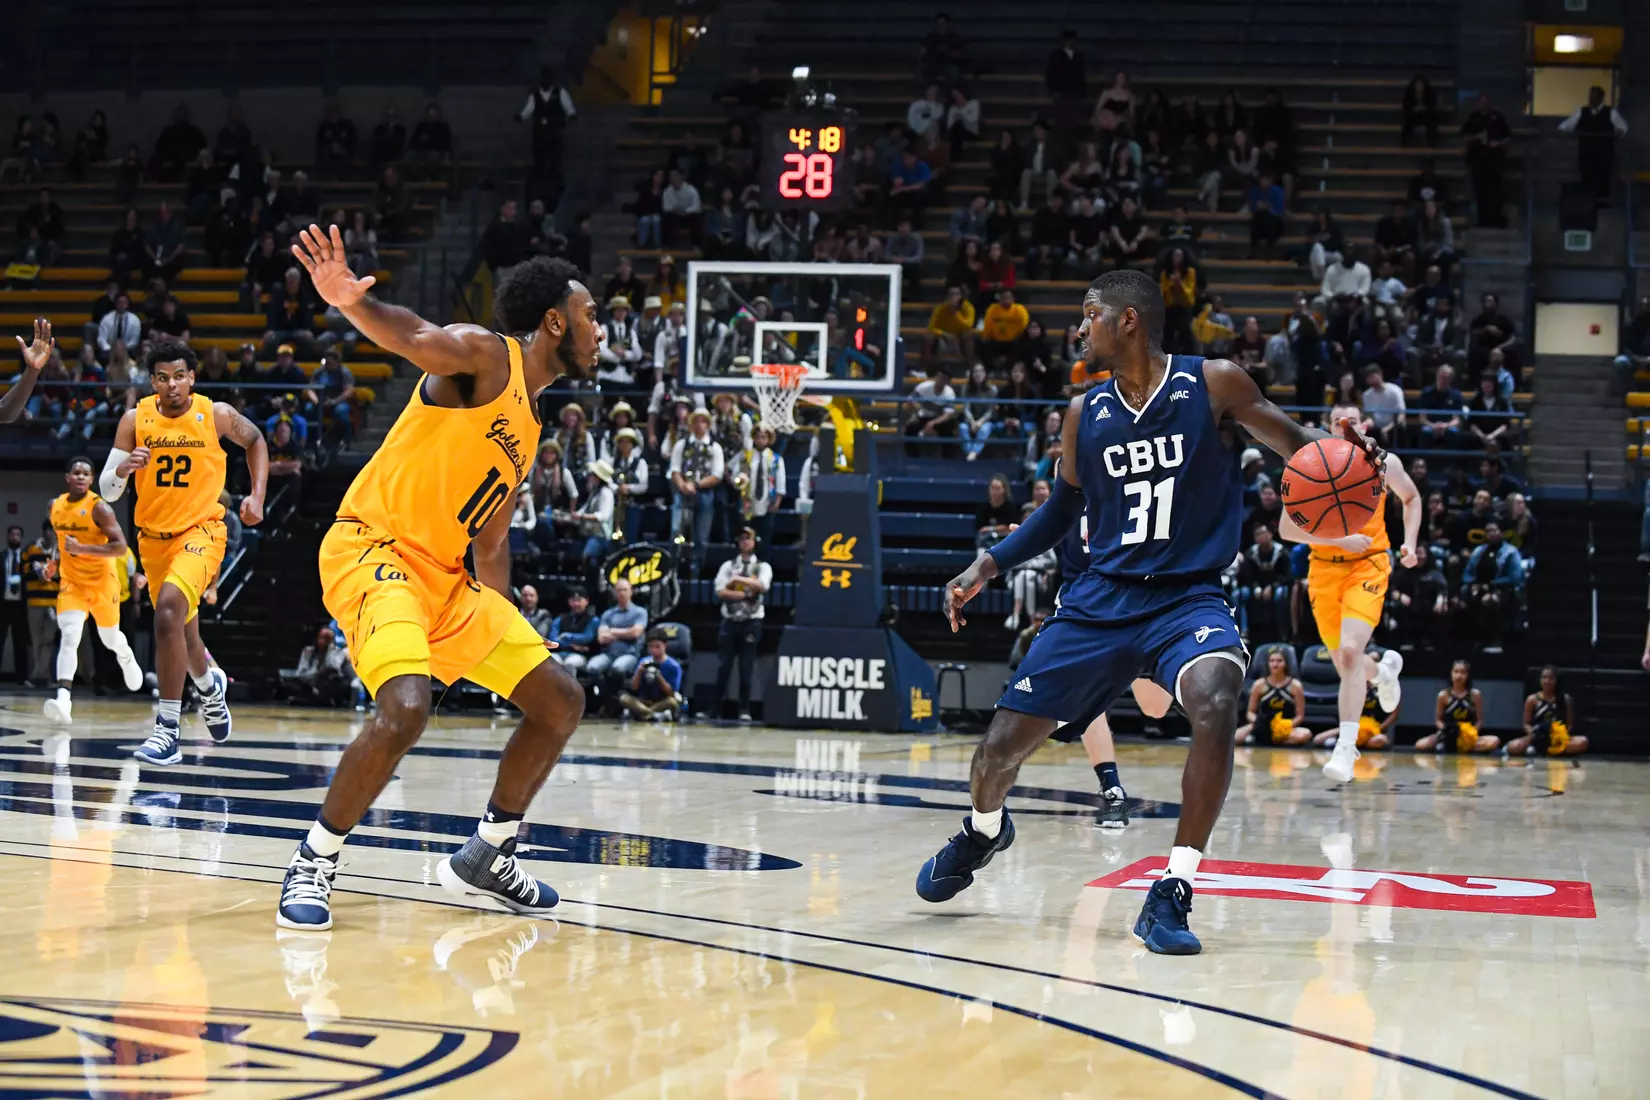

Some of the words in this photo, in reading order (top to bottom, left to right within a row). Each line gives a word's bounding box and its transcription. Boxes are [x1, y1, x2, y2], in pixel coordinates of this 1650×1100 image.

[789, 126, 840, 152] 4:18
[780, 153, 832, 198] 28
[1169, 390, 1190, 402] WAC
[143, 435, 175, 449] Golden
[176, 435, 206, 448] Bears
[486, 413, 521, 464] Golden
[156, 455, 191, 487] 22
[1103, 433, 1184, 478] CBU
[457, 466, 509, 538] 10
[1121, 476, 1175, 545] 31
[822, 532, 857, 561] Cal
[778, 655, 886, 690] MUSCLE
[796, 688, 864, 720] MILK
